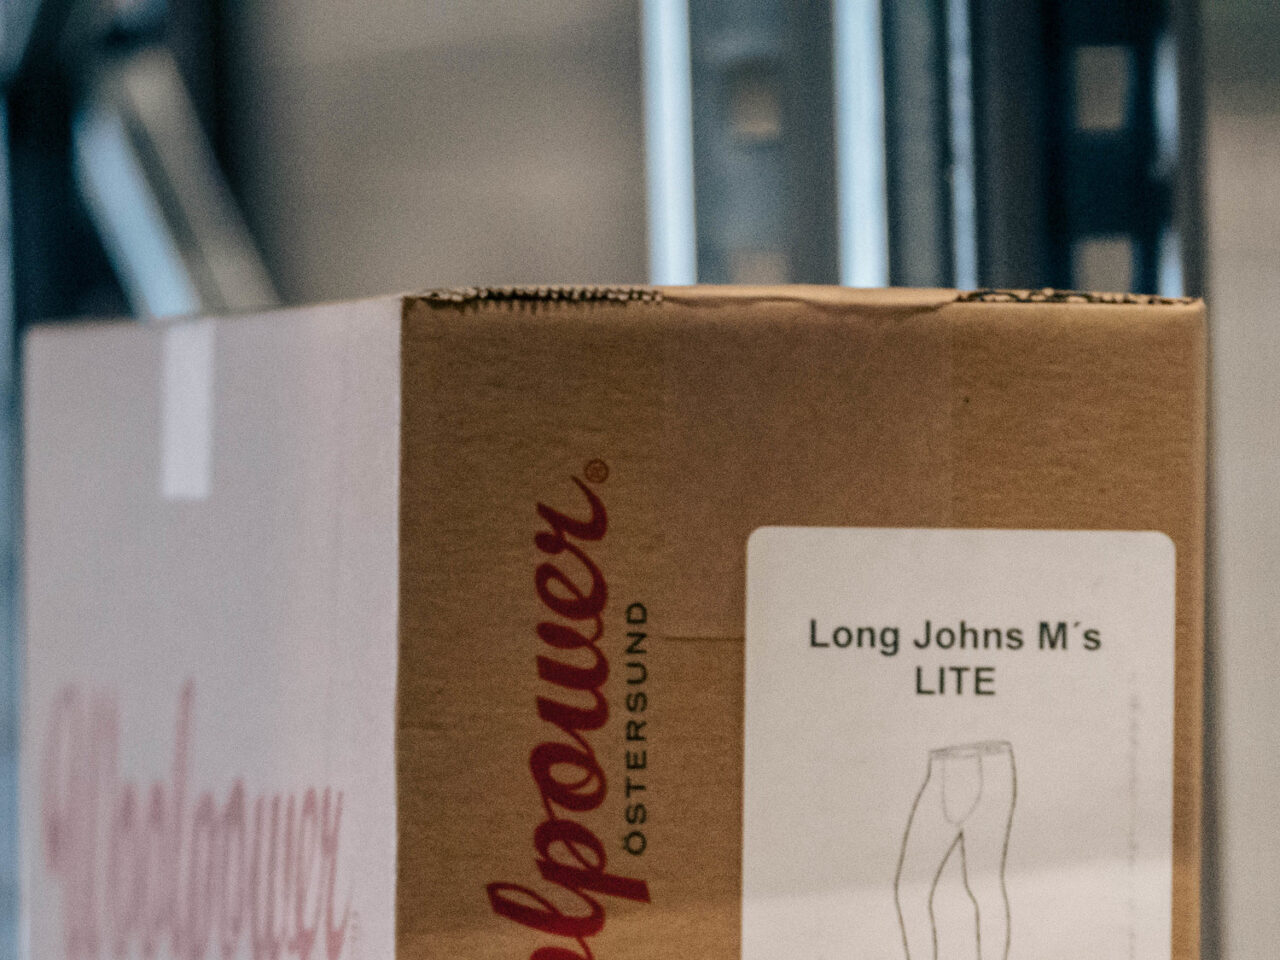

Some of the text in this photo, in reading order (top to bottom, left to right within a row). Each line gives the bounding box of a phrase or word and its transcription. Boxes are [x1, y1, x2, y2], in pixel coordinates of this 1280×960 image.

[809, 618, 900, 658] Long
[912, 619, 1025, 652] Johns
[915, 665, 996, 696] LITE
[621, 601, 649, 857] ÖSTERSUND
